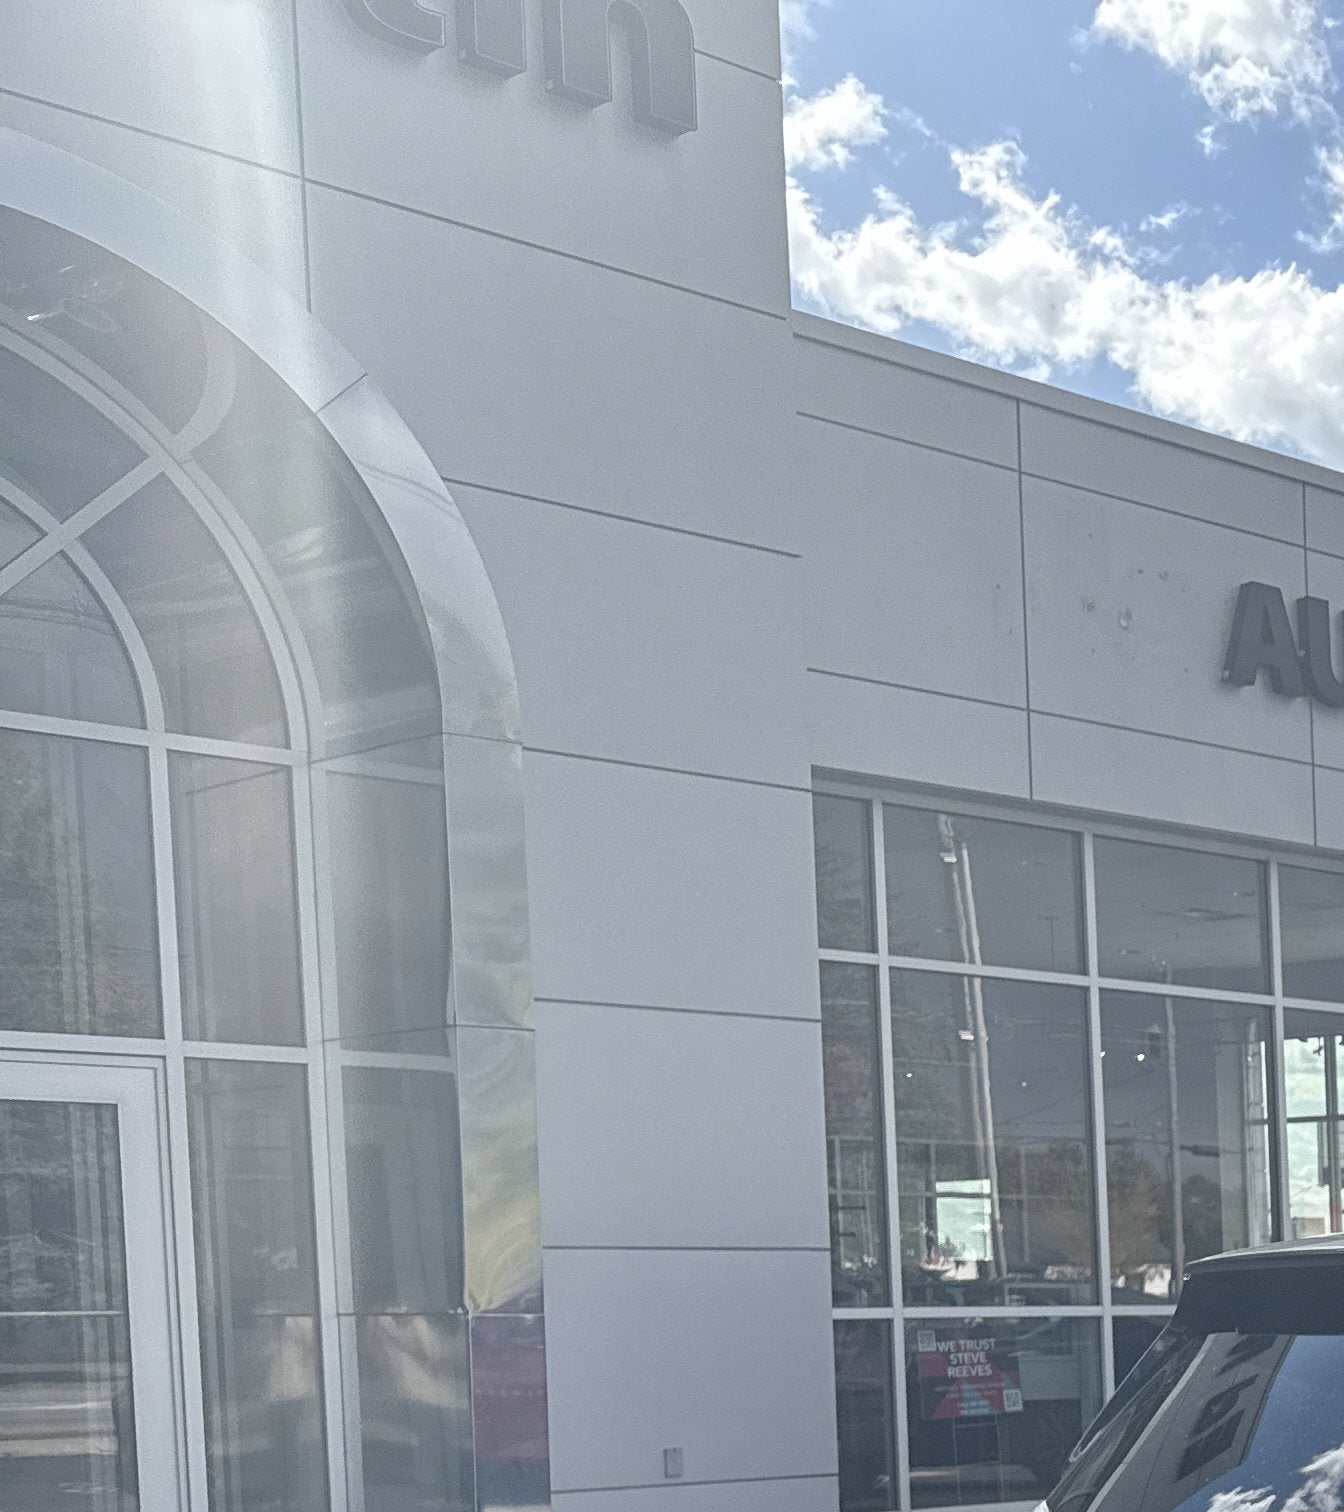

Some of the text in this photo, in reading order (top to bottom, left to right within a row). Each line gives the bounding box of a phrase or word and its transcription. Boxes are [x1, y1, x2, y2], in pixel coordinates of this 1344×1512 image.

[936, 1338, 996, 1352] WE TRUST
[950, 1352, 987, 1365] STEVE
[947, 1364, 992, 1378] REEVES
